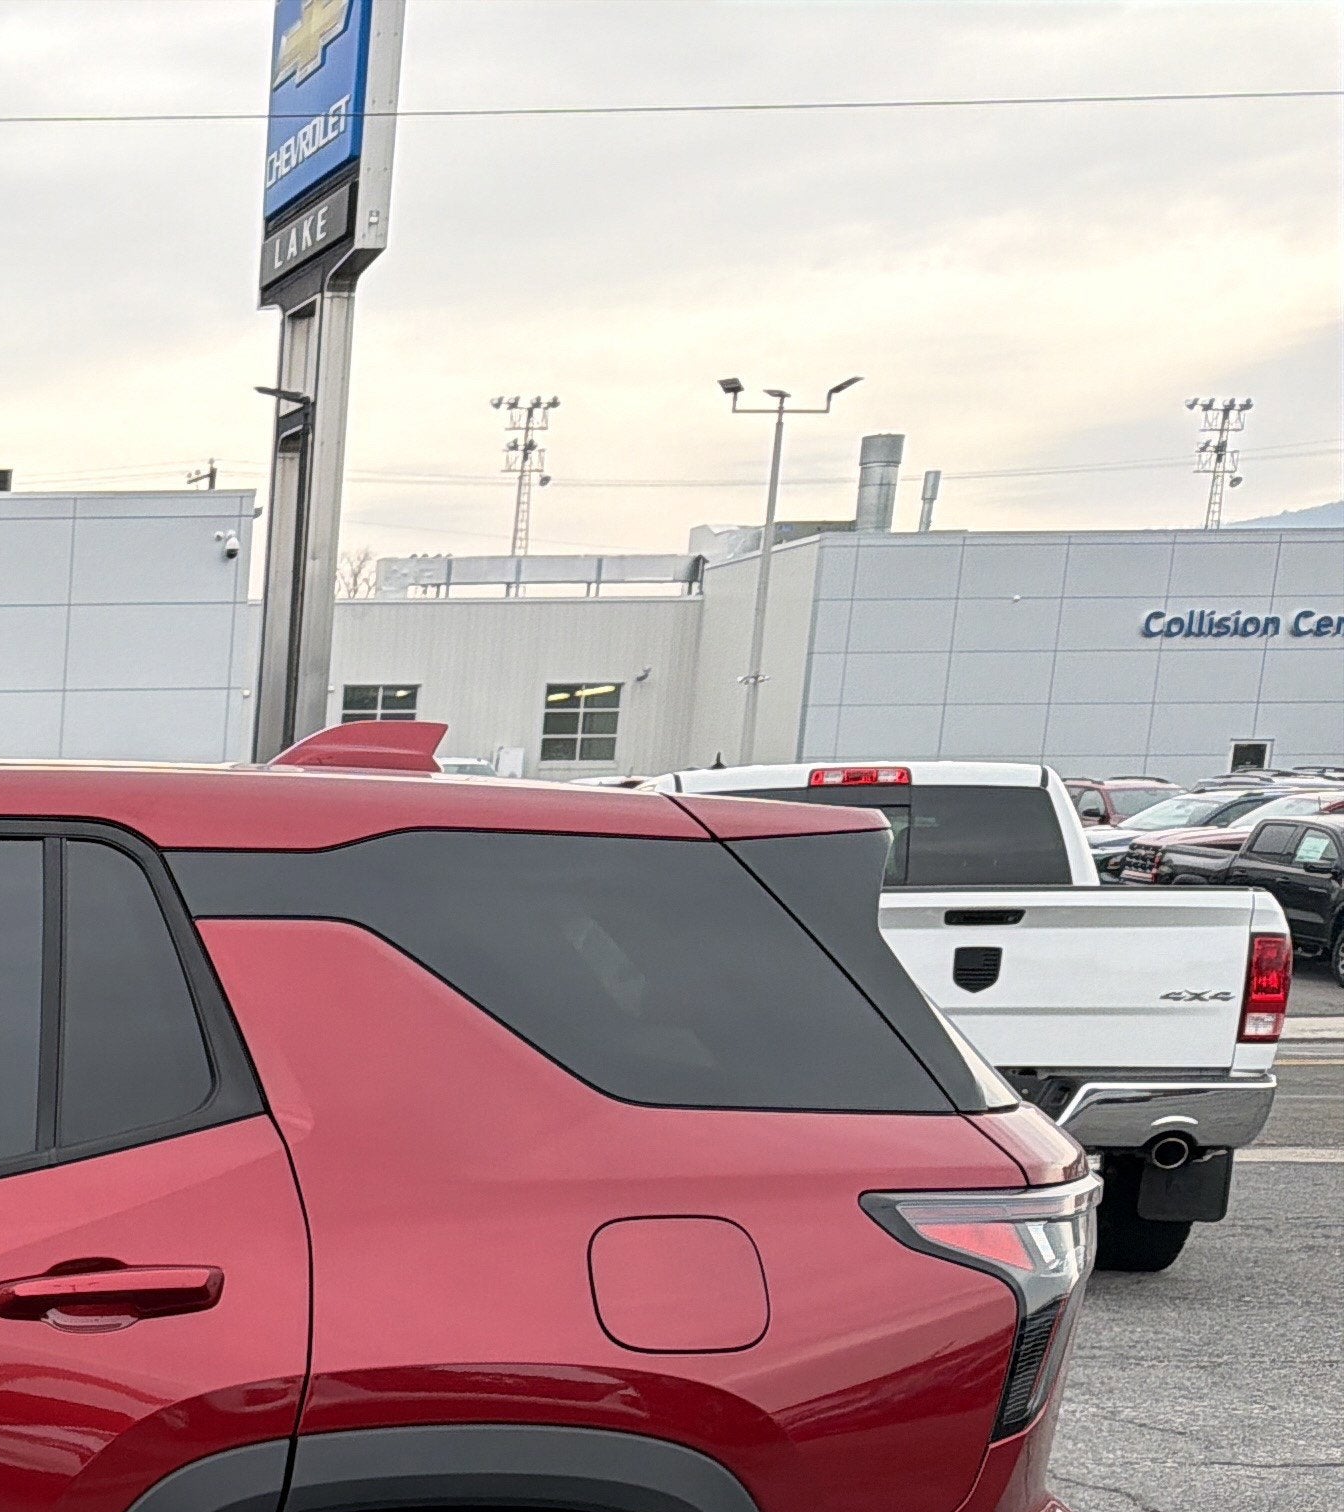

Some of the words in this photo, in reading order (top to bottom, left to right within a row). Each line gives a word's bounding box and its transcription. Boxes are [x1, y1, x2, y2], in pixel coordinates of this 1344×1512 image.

[266, 94, 351, 189] CHEVROLET
[274, 206, 328, 270] LAKE
[1142, 609, 1281, 638] Collision
